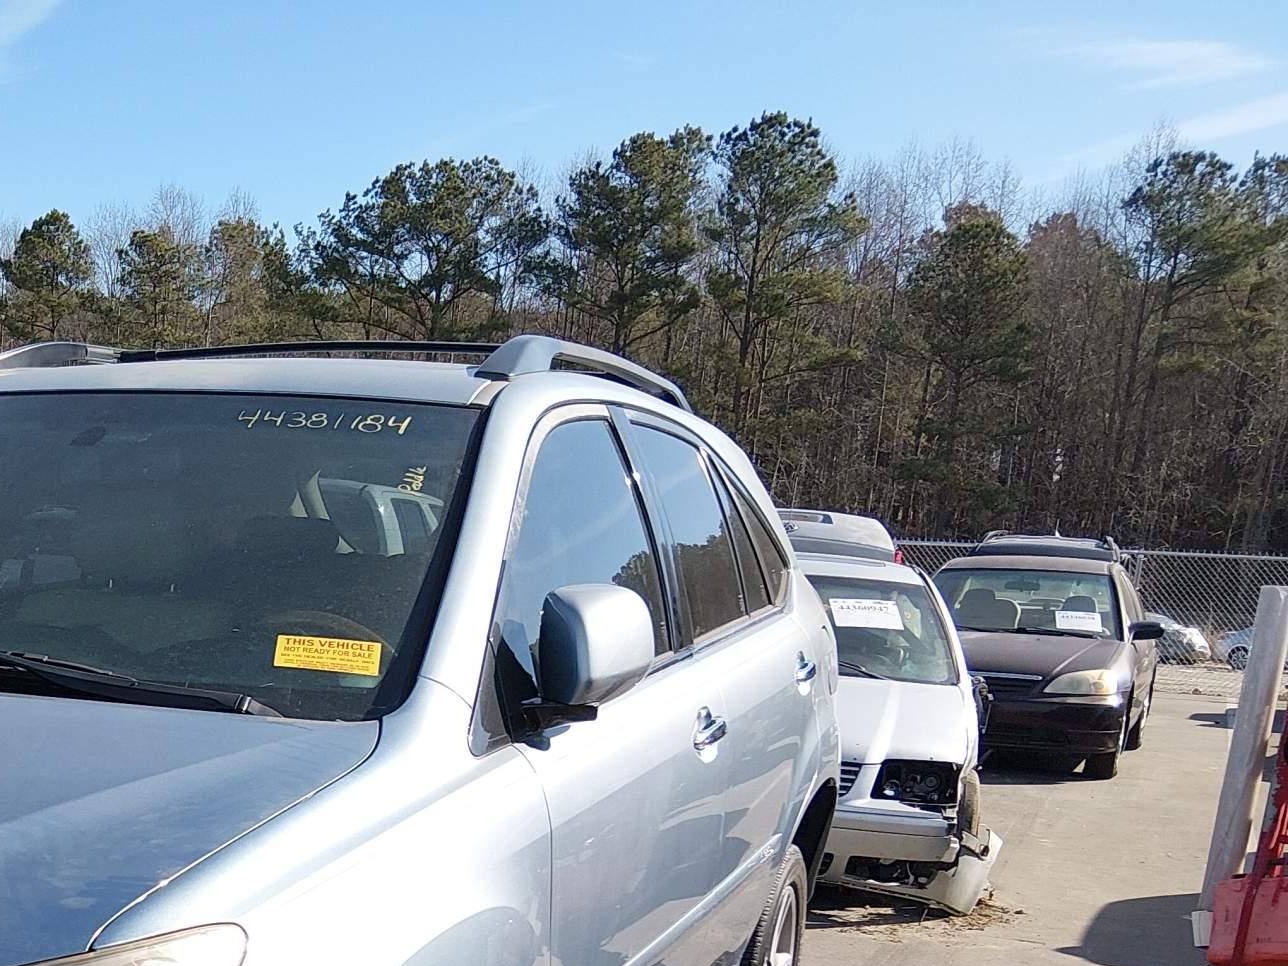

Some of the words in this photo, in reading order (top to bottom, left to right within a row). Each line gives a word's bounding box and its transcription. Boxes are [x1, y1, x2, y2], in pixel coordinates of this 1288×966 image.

[238, 409, 412, 435] 44381184
[285, 637, 315, 647] THIS
[318, 639, 375, 652] VEHICLE
[302, 647, 331, 656] READY
[332, 649, 350, 657] FOR
